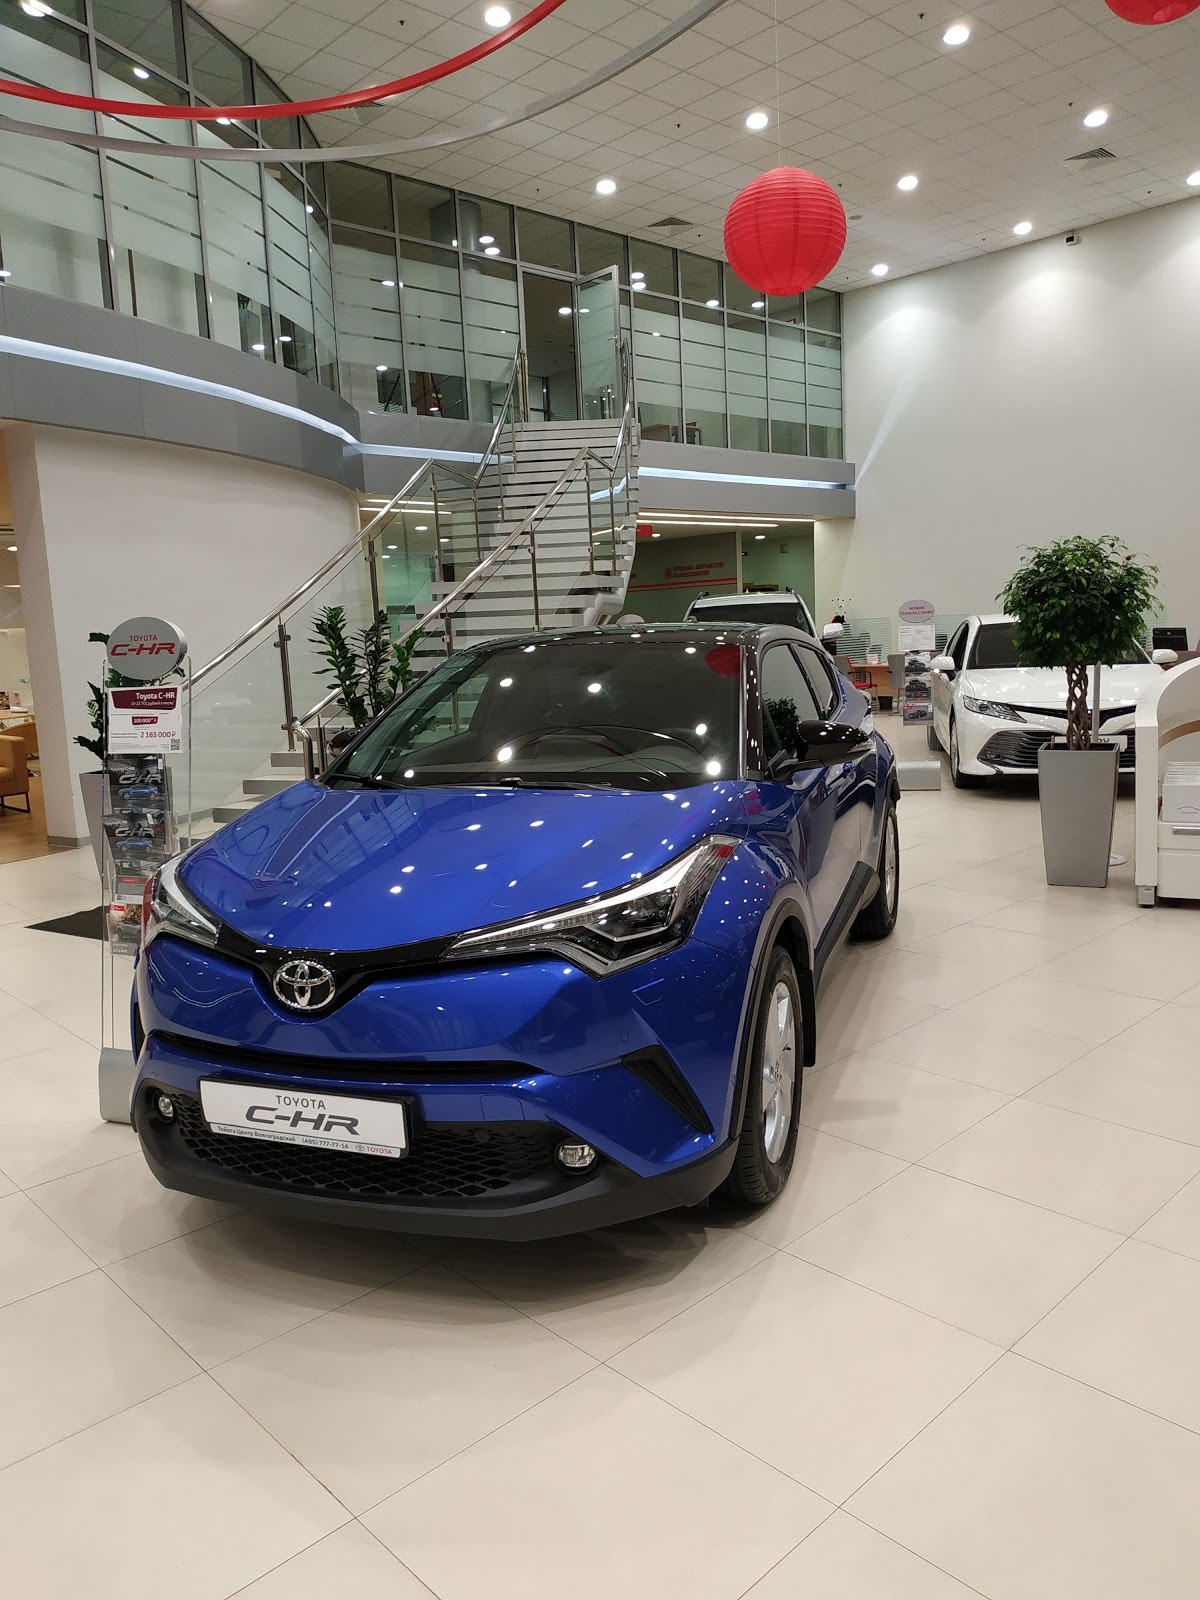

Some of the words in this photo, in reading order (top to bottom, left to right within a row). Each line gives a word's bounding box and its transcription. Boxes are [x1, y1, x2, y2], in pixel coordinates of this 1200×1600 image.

[130, 634, 158, 642] TOYOTA
[111, 642, 176, 656] C-HR
[135, 692, 157, 701] Toyota
[158, 691, 176, 699] C-HR
[275, 1095, 326, 1110] TOYOTA
[245, 1105, 360, 1136] C-HR
[217, 1125, 236, 1134] Тойота
[236, 1128, 253, 1137] Центр
[253, 1131, 296, 1142] Волгоградский
[301, 1137, 319, 1146] (495)
[319, 1141, 349, 1149] 777-77-14
[367, 1146, 393, 1155] TOYOTA
